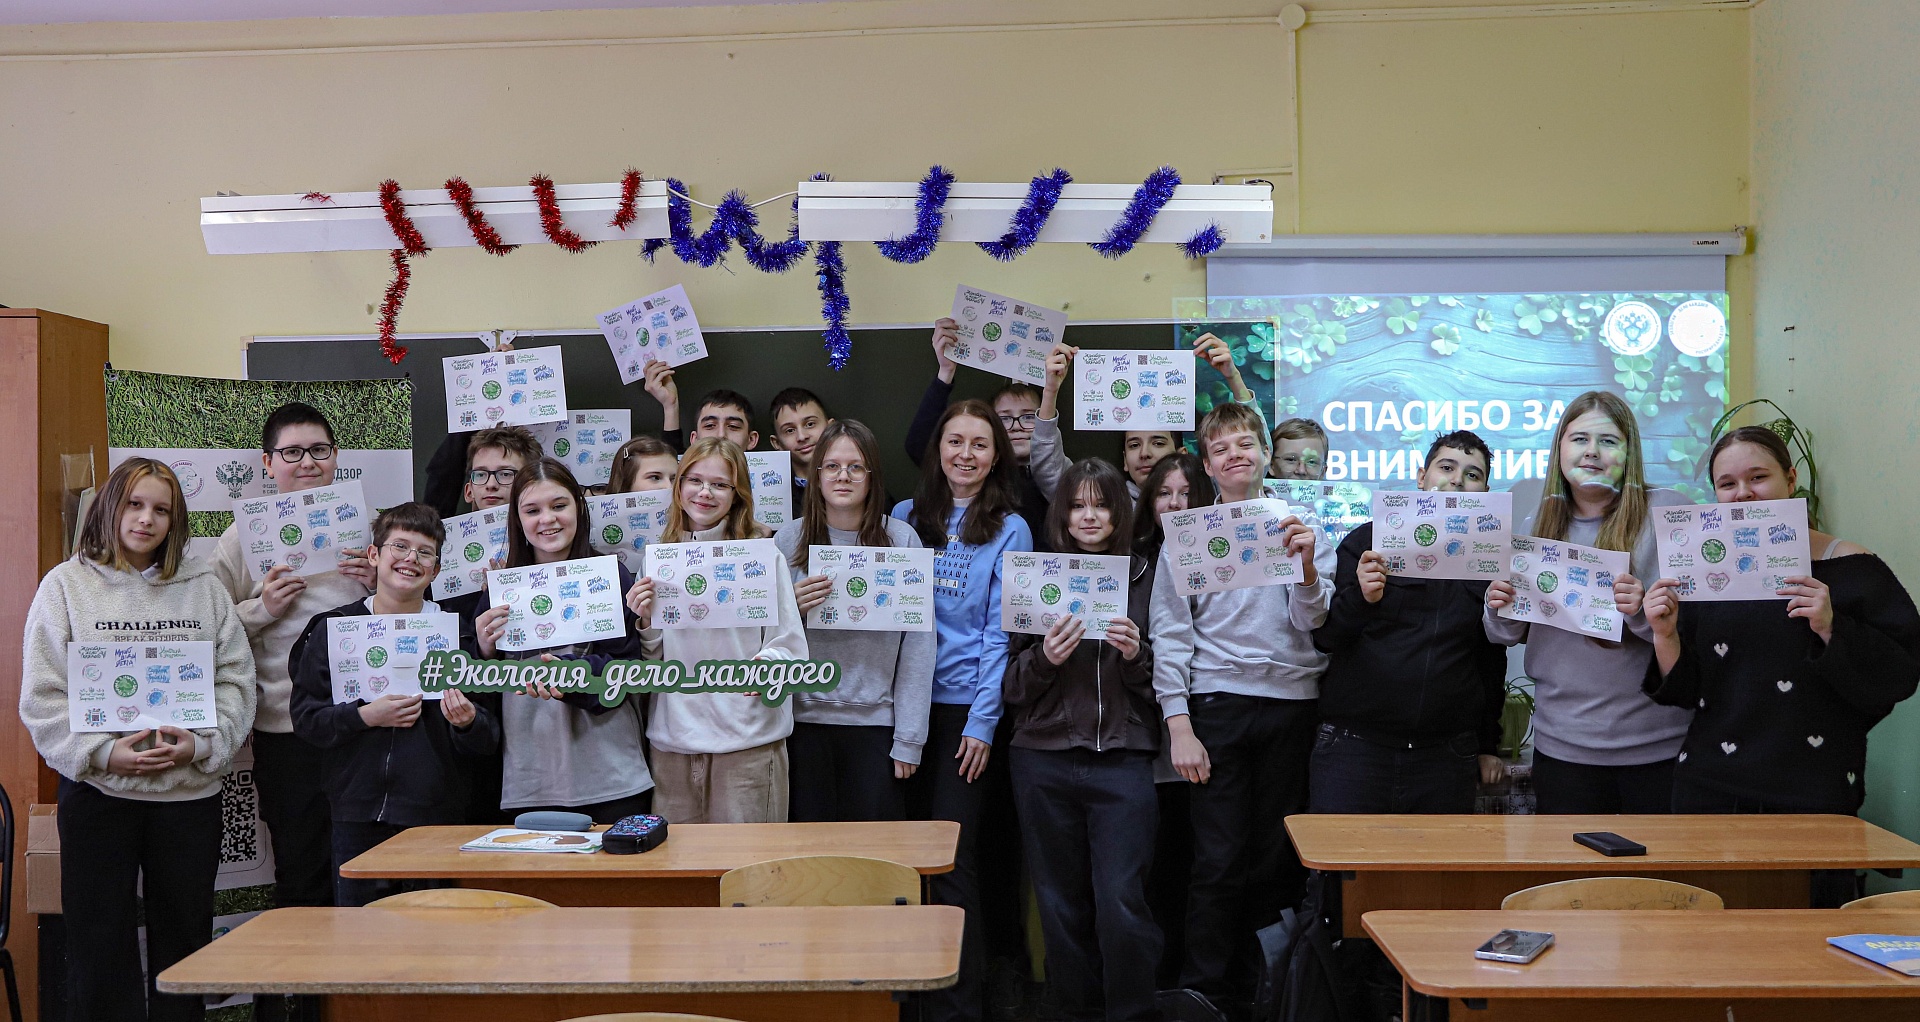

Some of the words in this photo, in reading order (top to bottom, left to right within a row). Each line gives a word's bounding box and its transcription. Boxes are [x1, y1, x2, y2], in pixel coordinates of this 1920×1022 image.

[1322, 400, 1511, 432] СПАСИБО
[1522, 400, 1566, 432] ЗА
[1326, 449, 1551, 480] ВНИИЕ
[95, 619, 202, 631] CHALLENGE
[422, 653, 591, 688] #Экология
